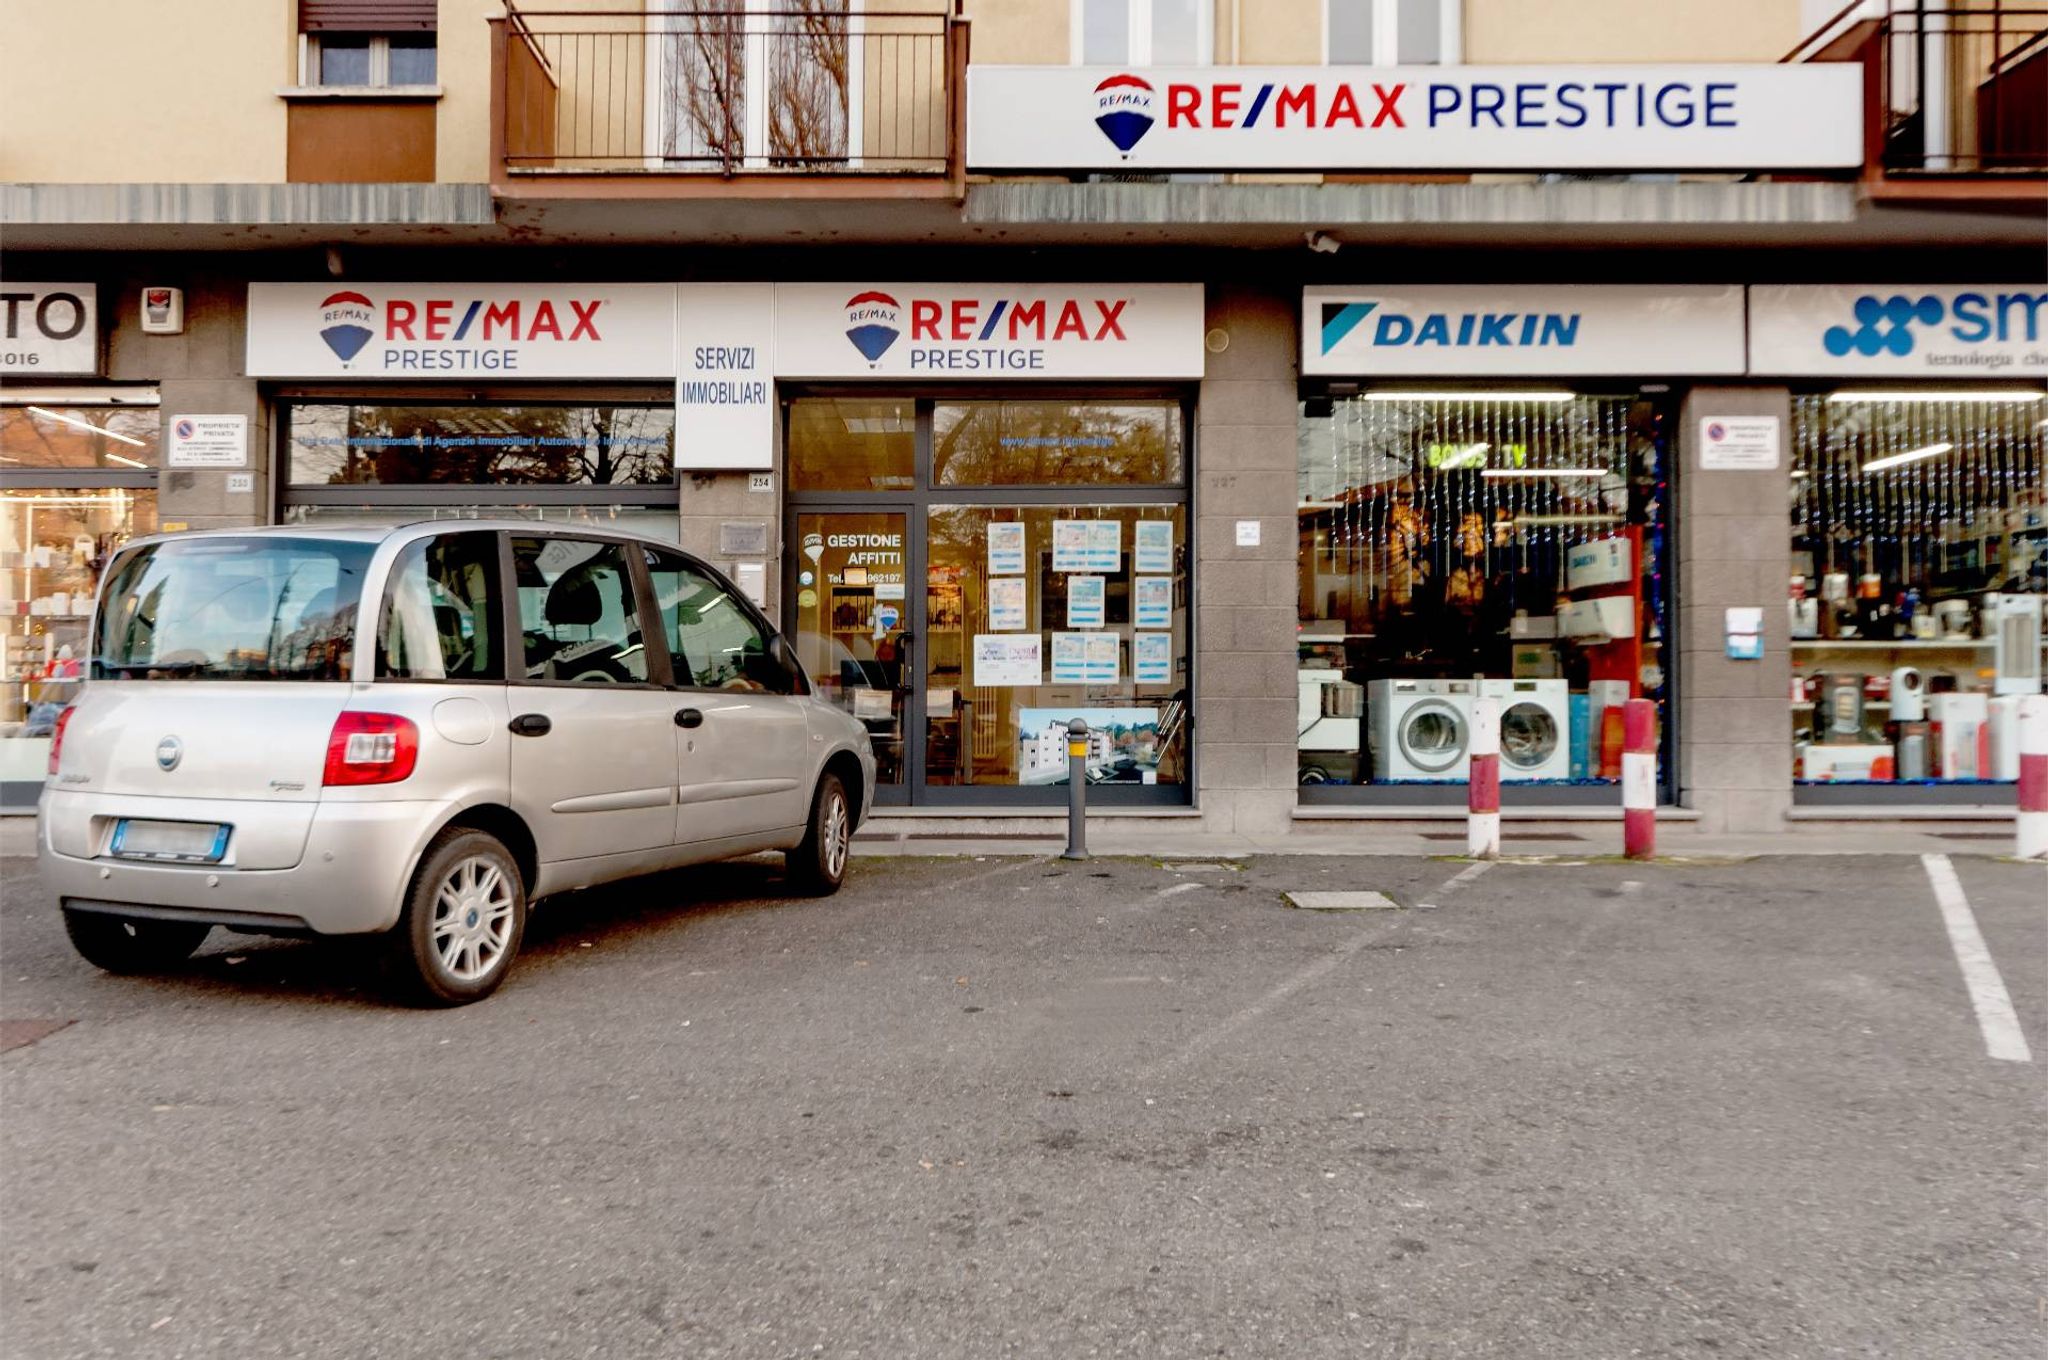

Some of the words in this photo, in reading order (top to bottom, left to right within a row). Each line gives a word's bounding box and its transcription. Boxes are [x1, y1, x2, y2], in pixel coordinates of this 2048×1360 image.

[1100, 93, 1151, 108] RE/MAX
[1167, 83, 1407, 129] RE/MAX
[1428, 83, 1738, 129] PRESTIGE
[0, 292, 87, 341] TO
[324, 309, 371, 323] RE/MAX
[385, 300, 603, 341] RE/MAX
[849, 308, 897, 323] RE/MAX
[911, 300, 1128, 341] RE/MAX
[1372, 313, 1582, 347] DAIKIN
[0, 352, 40, 366] 016
[384, 349, 519, 370] PRESTIGE
[695, 347, 756, 370] SERVIZI
[910, 349, 1045, 370] PRESTIGE
[682, 381, 767, 405] IMMOBILIARI
[827, 534, 902, 548] GESTIONE
[847, 552, 901, 565] AFFITTI
[827, 573, 844, 584] Tel.
